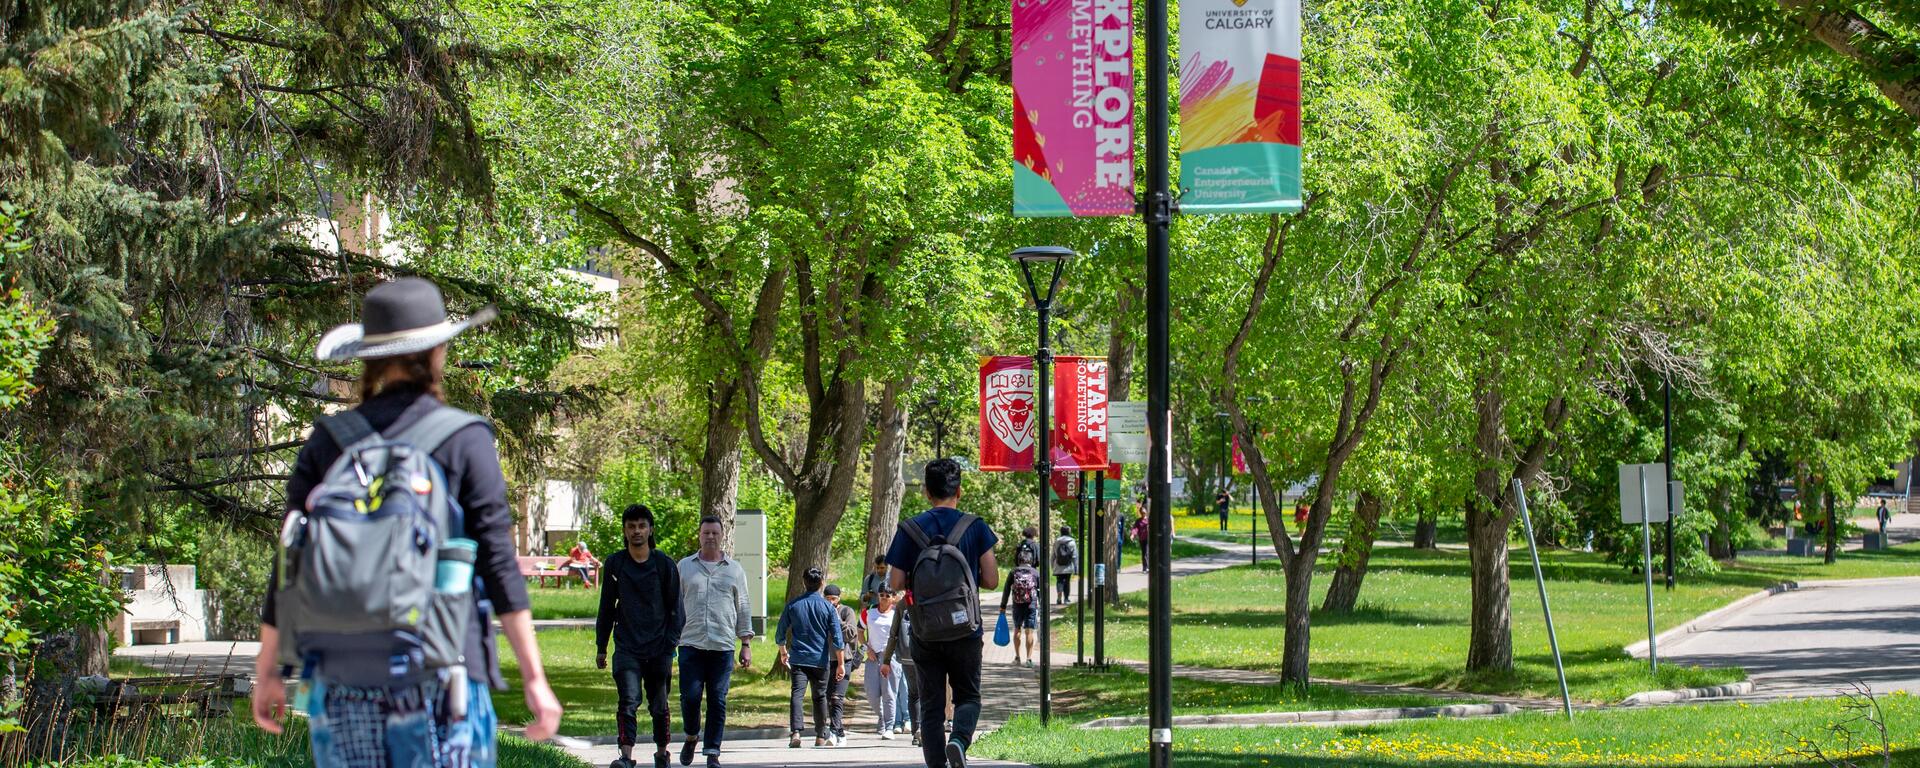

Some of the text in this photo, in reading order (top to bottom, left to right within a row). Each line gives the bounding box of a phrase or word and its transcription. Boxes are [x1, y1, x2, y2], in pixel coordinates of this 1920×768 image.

[1206, 9, 1259, 17] UNIVERSITY
[1205, 17, 1274, 30] CALGARY
[1072, 0, 1093, 129] METHING
[1095, 0, 1130, 188] XPLORE
[1194, 166, 1239, 175] Canada's
[1194, 177, 1275, 189] Entrepreneurial
[1194, 189, 1248, 200] University
[1077, 359, 1087, 432] SOMETHING
[1087, 359, 1107, 443] START
